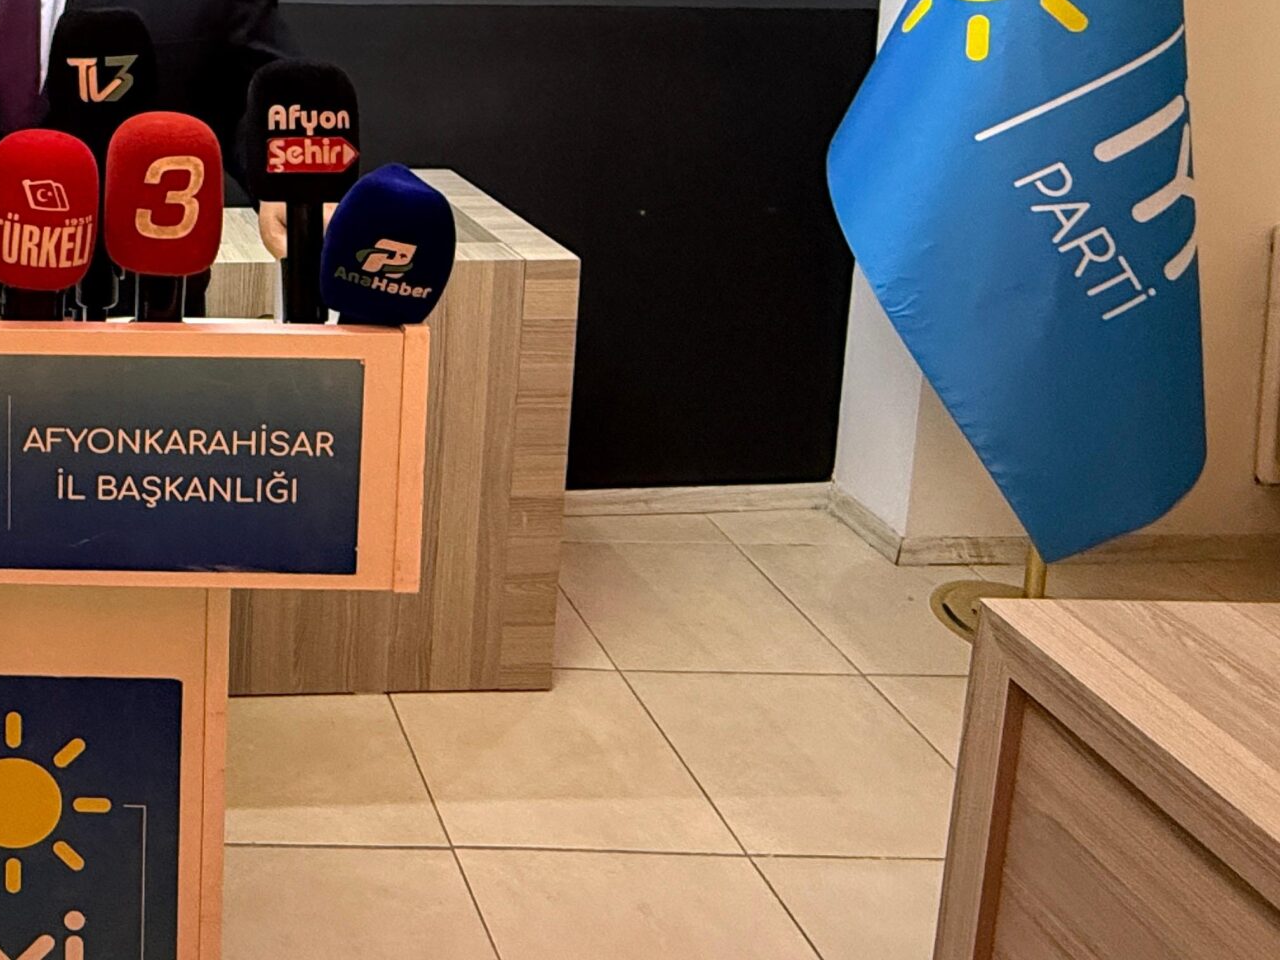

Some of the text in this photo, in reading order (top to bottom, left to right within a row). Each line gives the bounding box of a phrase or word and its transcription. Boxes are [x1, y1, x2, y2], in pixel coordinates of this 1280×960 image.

[268, 104, 350, 136] Afyon
[269, 138, 341, 173] Şehir
[135, 155, 205, 239] 3
[1014, 162, 1156, 320] PARTİ
[334, 266, 432, 298] AnaHaber
[22, 424, 335, 458] AFYONKARAHİSAR
[56, 467, 298, 508] İL BAŞKANLIĞI
